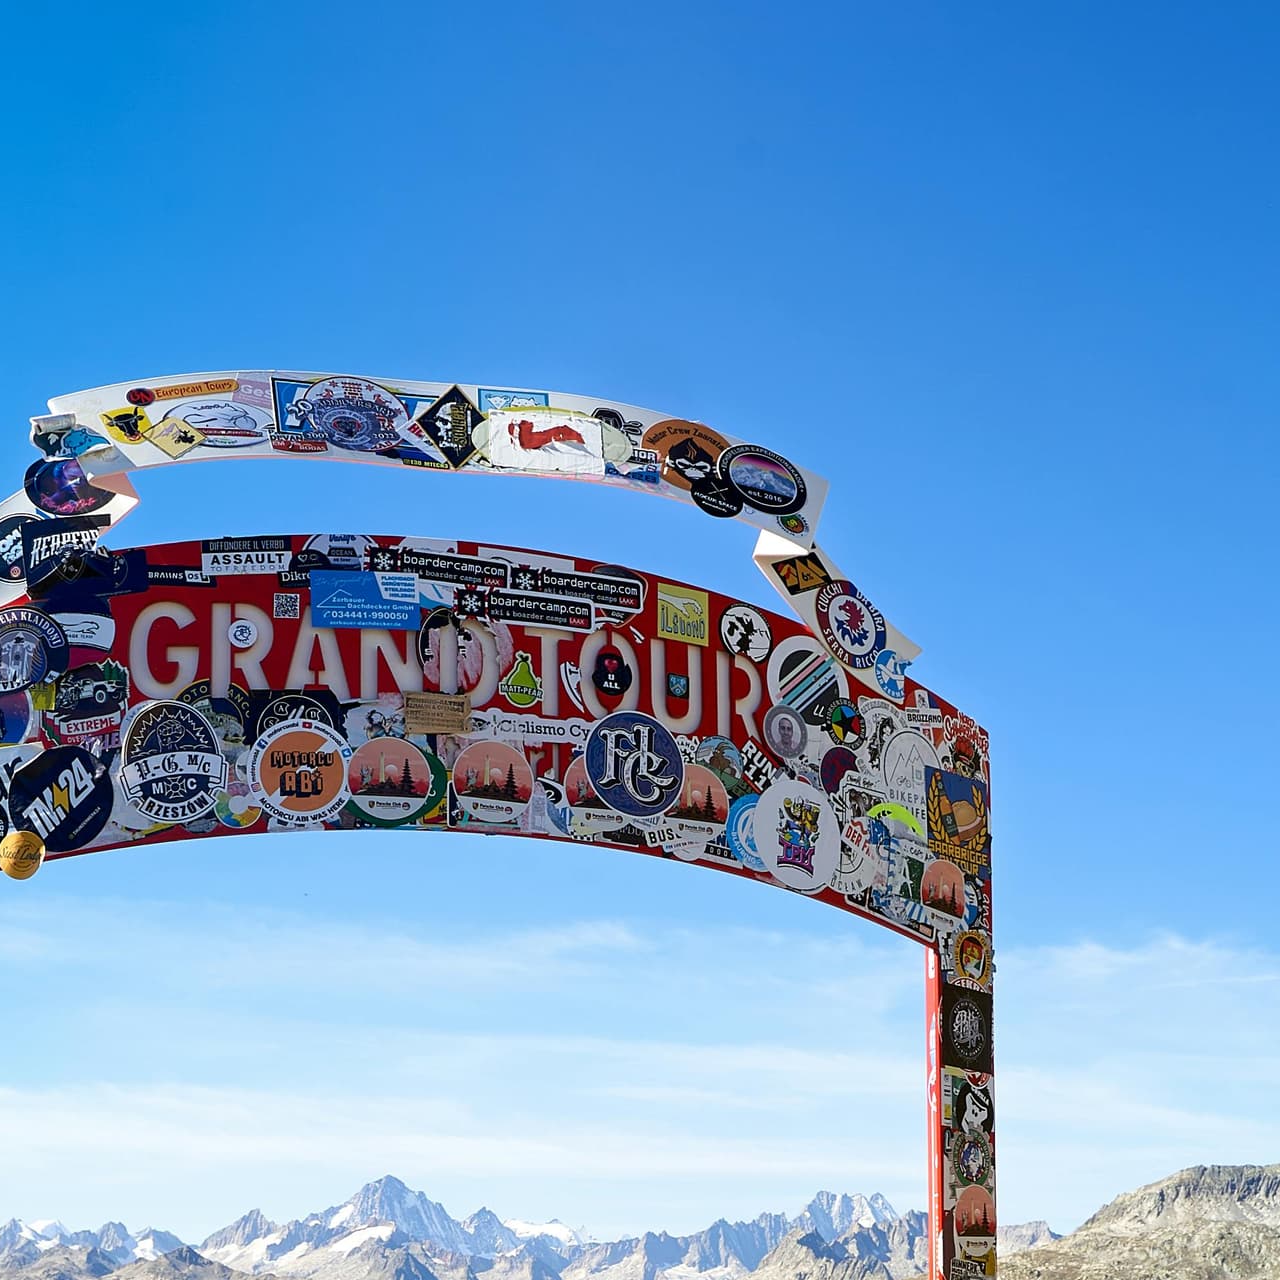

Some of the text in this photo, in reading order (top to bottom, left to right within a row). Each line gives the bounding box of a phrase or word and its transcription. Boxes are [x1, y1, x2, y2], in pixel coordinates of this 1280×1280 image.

[155, 379, 233, 399] European Tours
[209, 539, 284, 551] DIFFONDERE IL VERBO
[211, 553, 285, 565] ASSAULT
[403, 553, 505, 577] boardercamp.com
[425, 570, 500, 586] boarder camps LAAX
[543, 574, 639, 597] boardercamp.com
[490, 596, 589, 617] boardercamp.com
[596, 595, 618, 604] camps
[619, 597, 635, 606] LAAX
[818, 582, 843, 613] CIUCCHI
[331, 611, 408, 620] 034441-990050
[490, 608, 586, 626] ski boarder camps LAAX
[823, 627, 850, 664] SERRA
[130, 598, 500, 712] GRAND
[524, 625, 763, 743] TOUR
[603, 681, 620, 690] ALL
[66, 716, 116, 735] EXTREME
[907, 713, 942, 724] BRUZZANO
[500, 720, 567, 736] Ciclismo
[271, 750, 335, 767] MOTORCU
[742, 740, 778, 781] RUN
[145, 793, 210, 818] RZESZÓW
[259, 796, 345, 823] MOTORCU ABI WAS HERE
[845, 828, 862, 845] DER
[928, 839, 989, 867] SAARBRIGGE
[956, 858, 980, 876] TOUR
